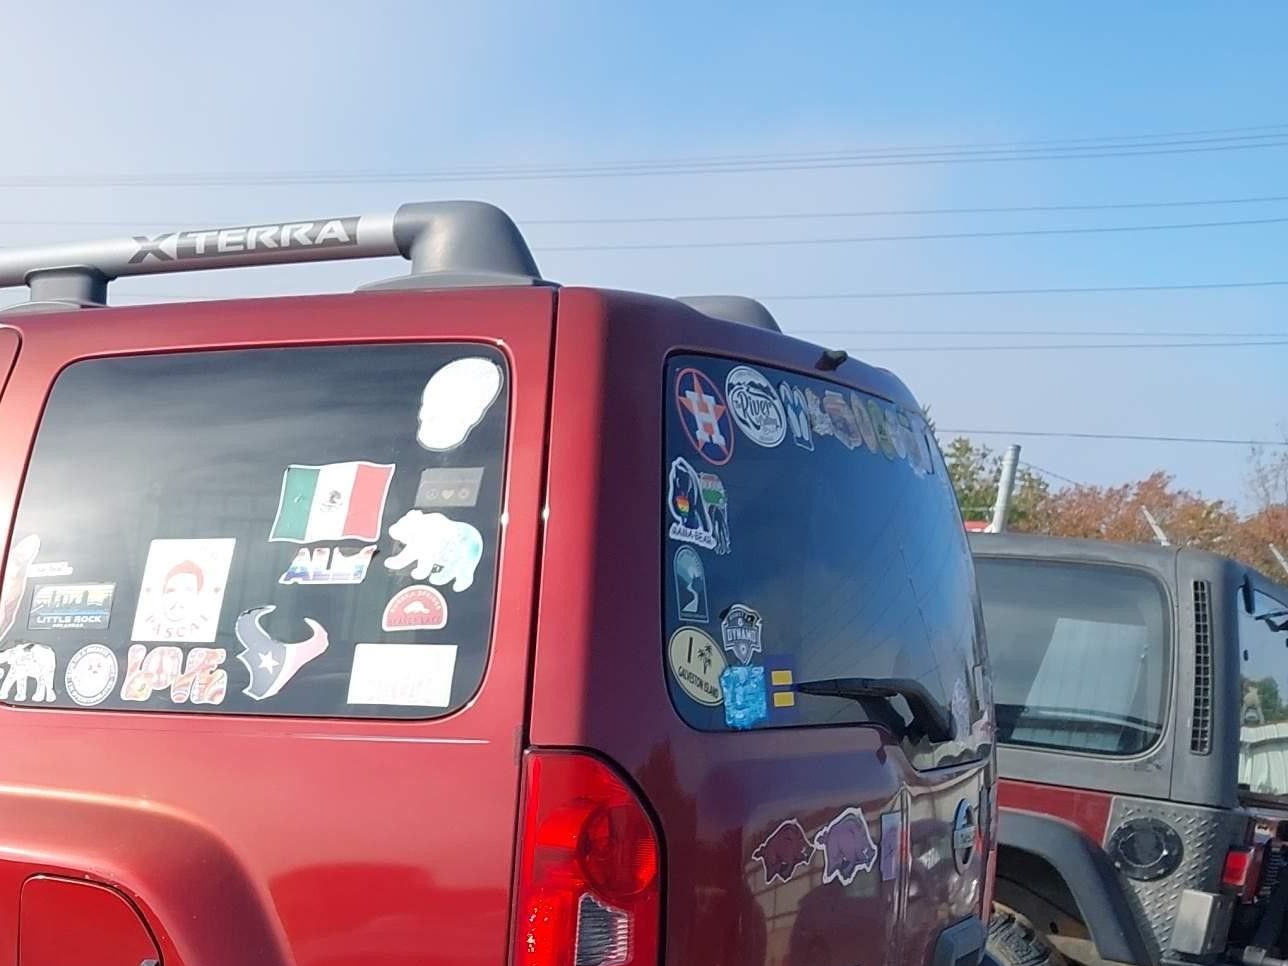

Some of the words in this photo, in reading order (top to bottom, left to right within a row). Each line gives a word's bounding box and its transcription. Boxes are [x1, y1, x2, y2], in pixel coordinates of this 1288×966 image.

[128, 219, 350, 264] XTERRA
[736, 391, 774, 419] River
[36, 616, 71, 624] LITTLE
[73, 615, 102, 623] ROCK
[727, 628, 757, 643] DYNAMO
[687, 637, 693, 663] I
[678, 666, 704, 692] GALVESTON
[704, 682, 719, 699] ISLAND
